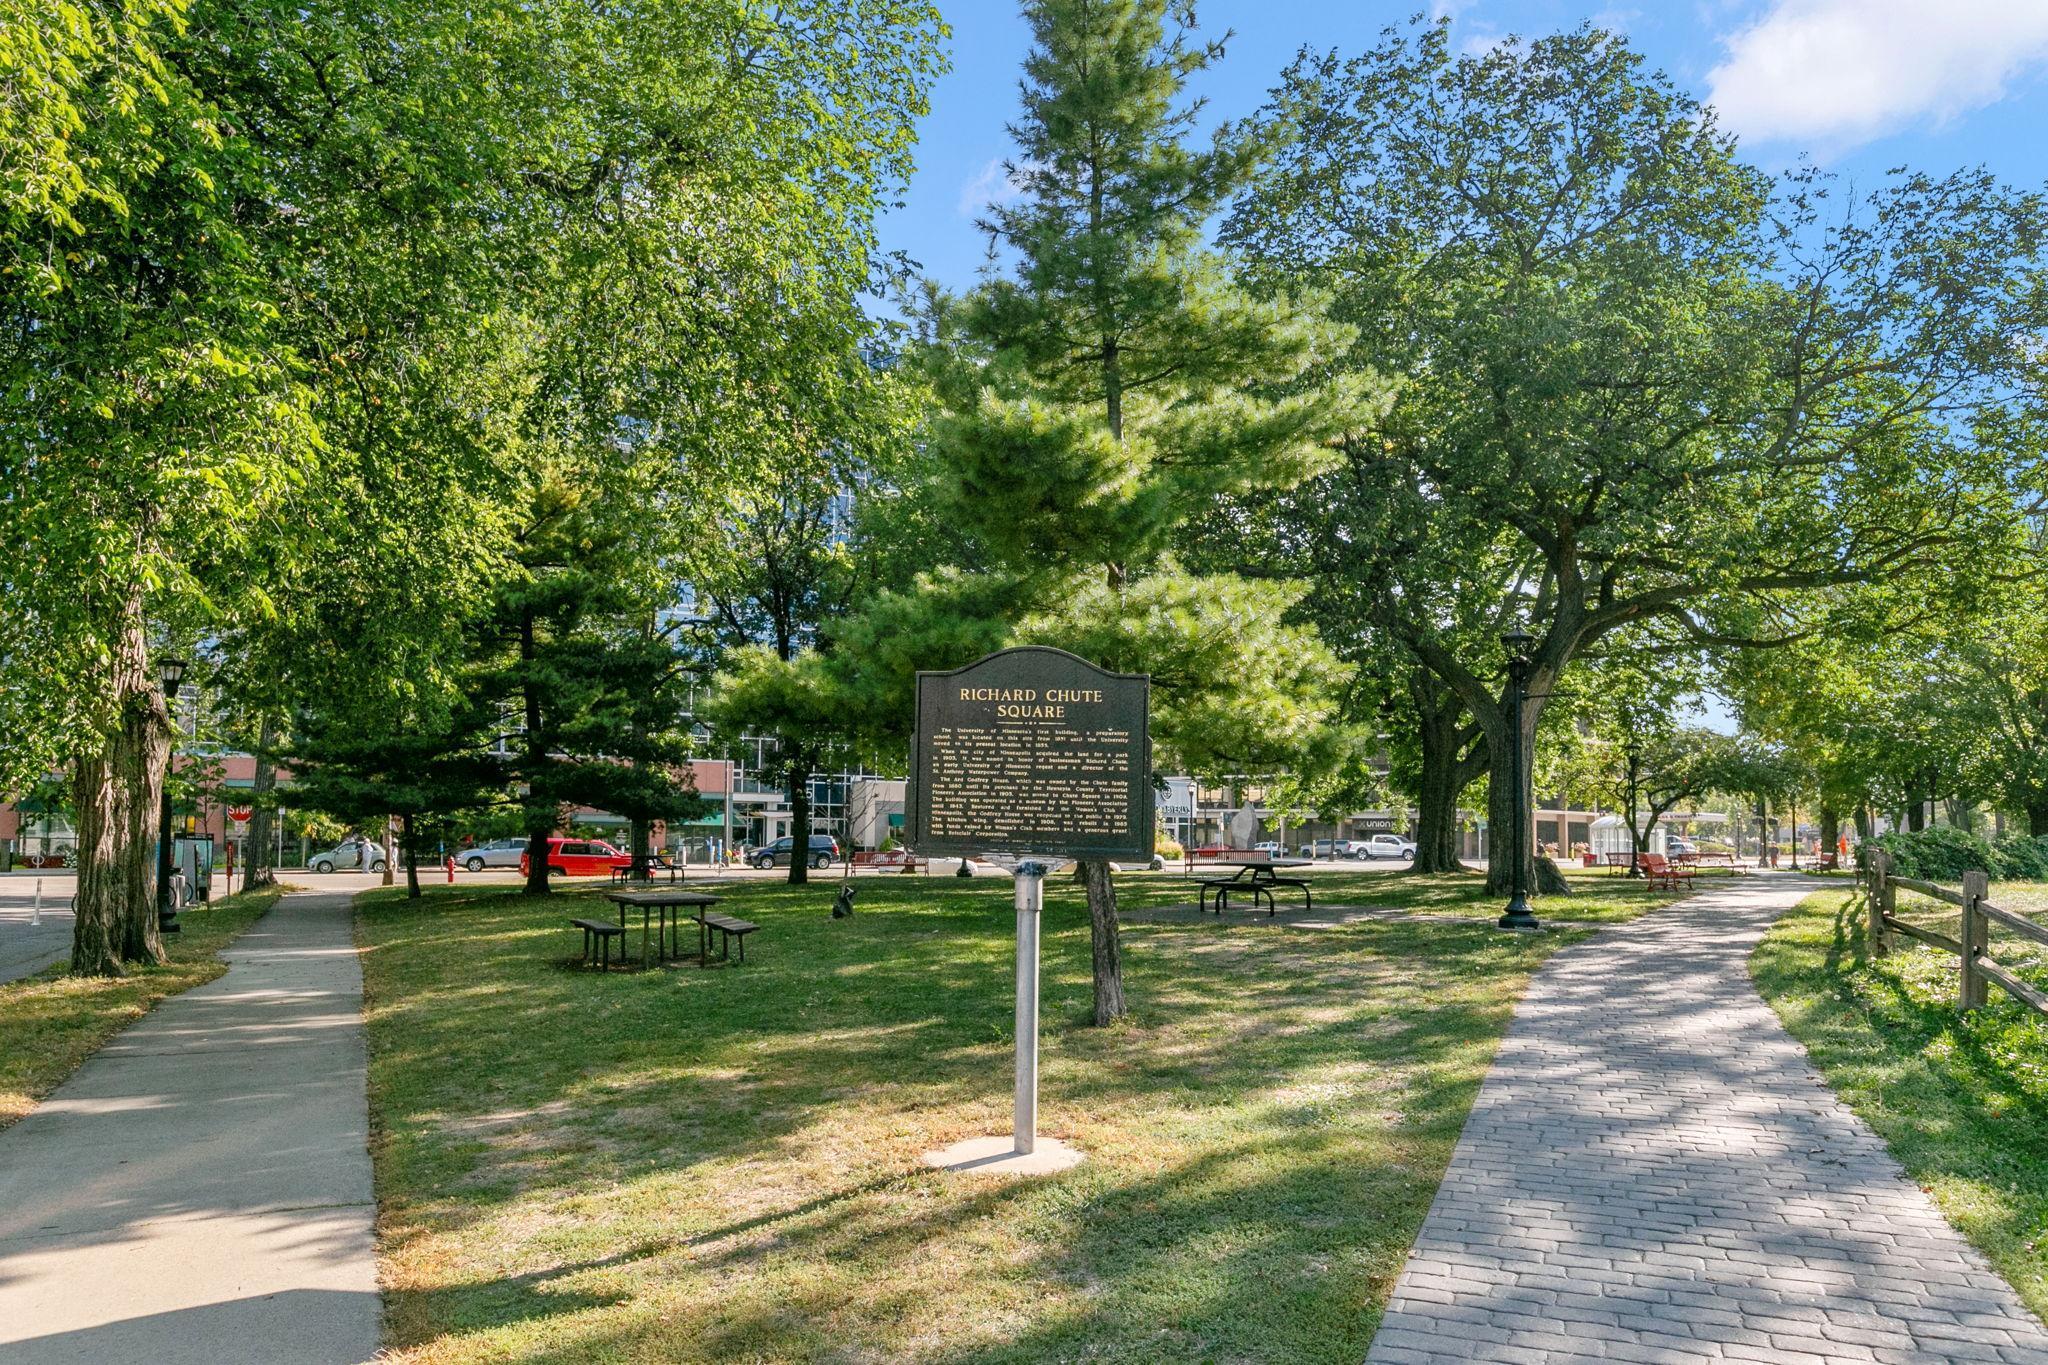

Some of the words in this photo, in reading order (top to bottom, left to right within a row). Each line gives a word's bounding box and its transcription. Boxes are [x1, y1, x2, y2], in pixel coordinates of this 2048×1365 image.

[960, 689, 1036, 701] RICHARD
[1046, 690, 1102, 702] CHUTE
[997, 705, 1065, 718] SQUARE
[228, 805, 253, 815] STOP
